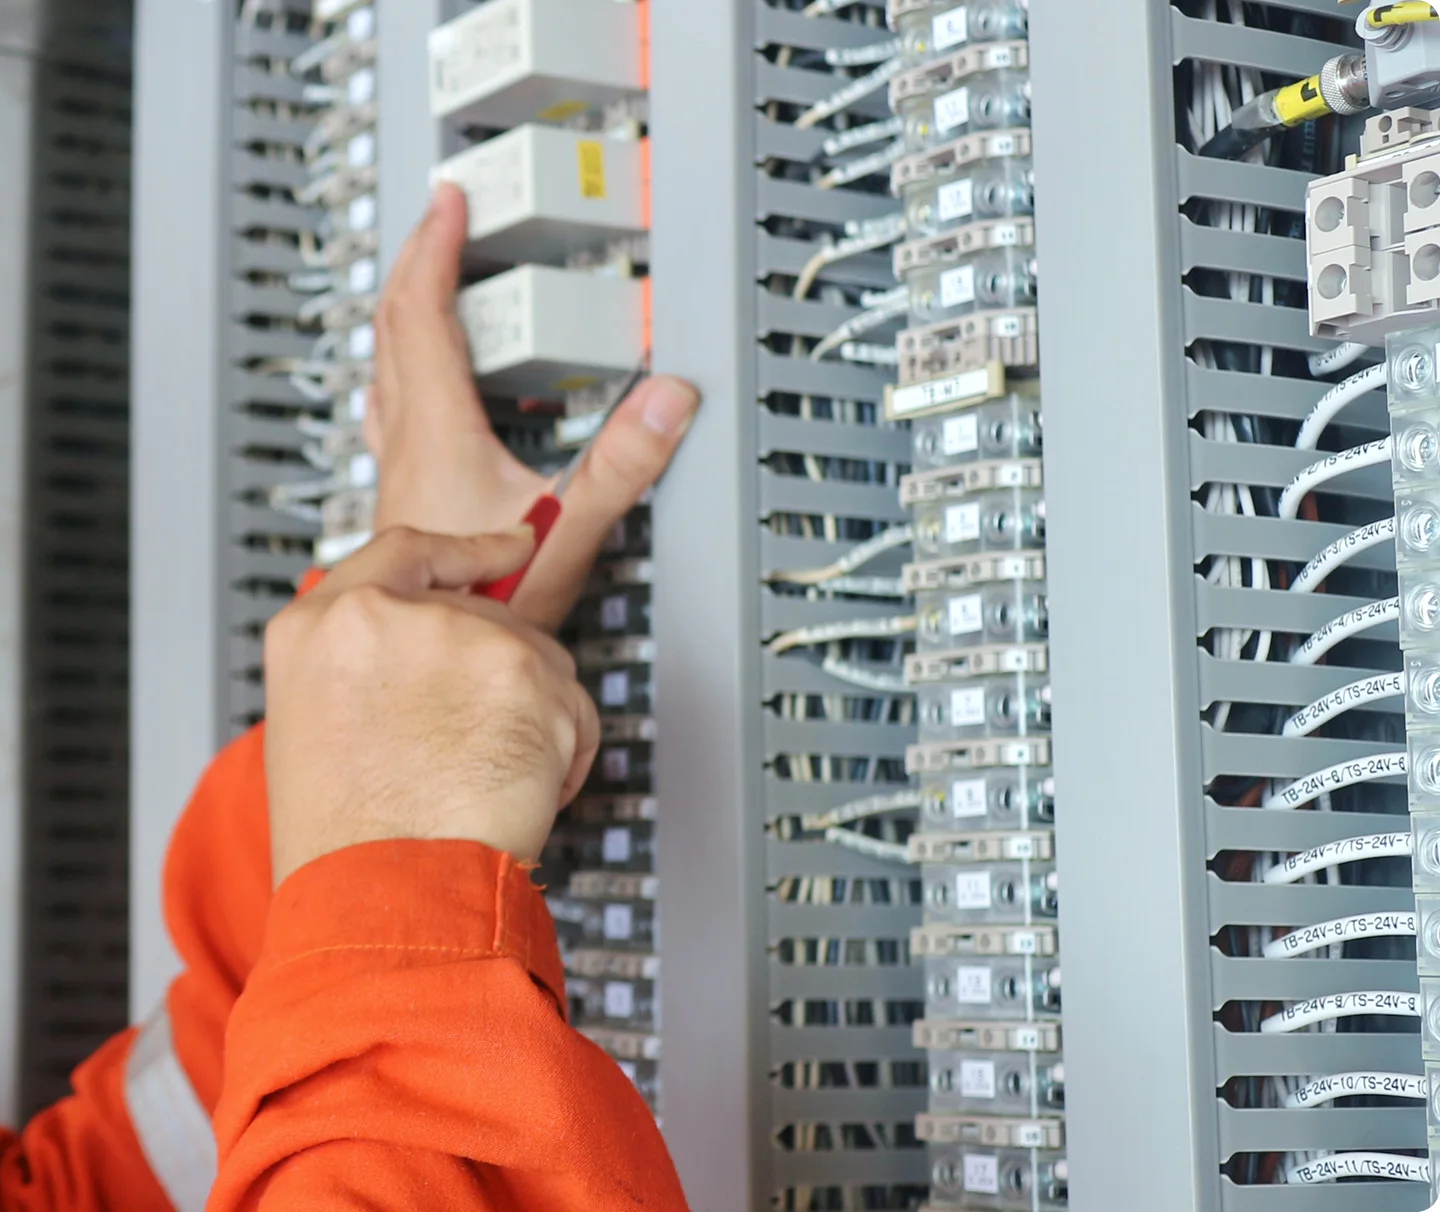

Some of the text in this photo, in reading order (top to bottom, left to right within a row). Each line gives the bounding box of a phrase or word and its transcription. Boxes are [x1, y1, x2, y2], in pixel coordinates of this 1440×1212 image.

[1301, 599, 1400, 653] TB-24V-4/TS-24V-4
[1291, 677, 1400, 730] TB-24V-5/TS-24V-5
[1281, 756, 1405, 805] TB-24V-6/TS-24V-6
[1283, 834, 1411, 873] TB-24V-7/TS-24V-7
[1282, 917, 1415, 951] TB-24V-8/TS-24V-8
[1280, 994, 1416, 1022] TB-24V-9/TS-24V-9
[1296, 1160, 1429, 1183] TB-24V-11/TS-24V-11
